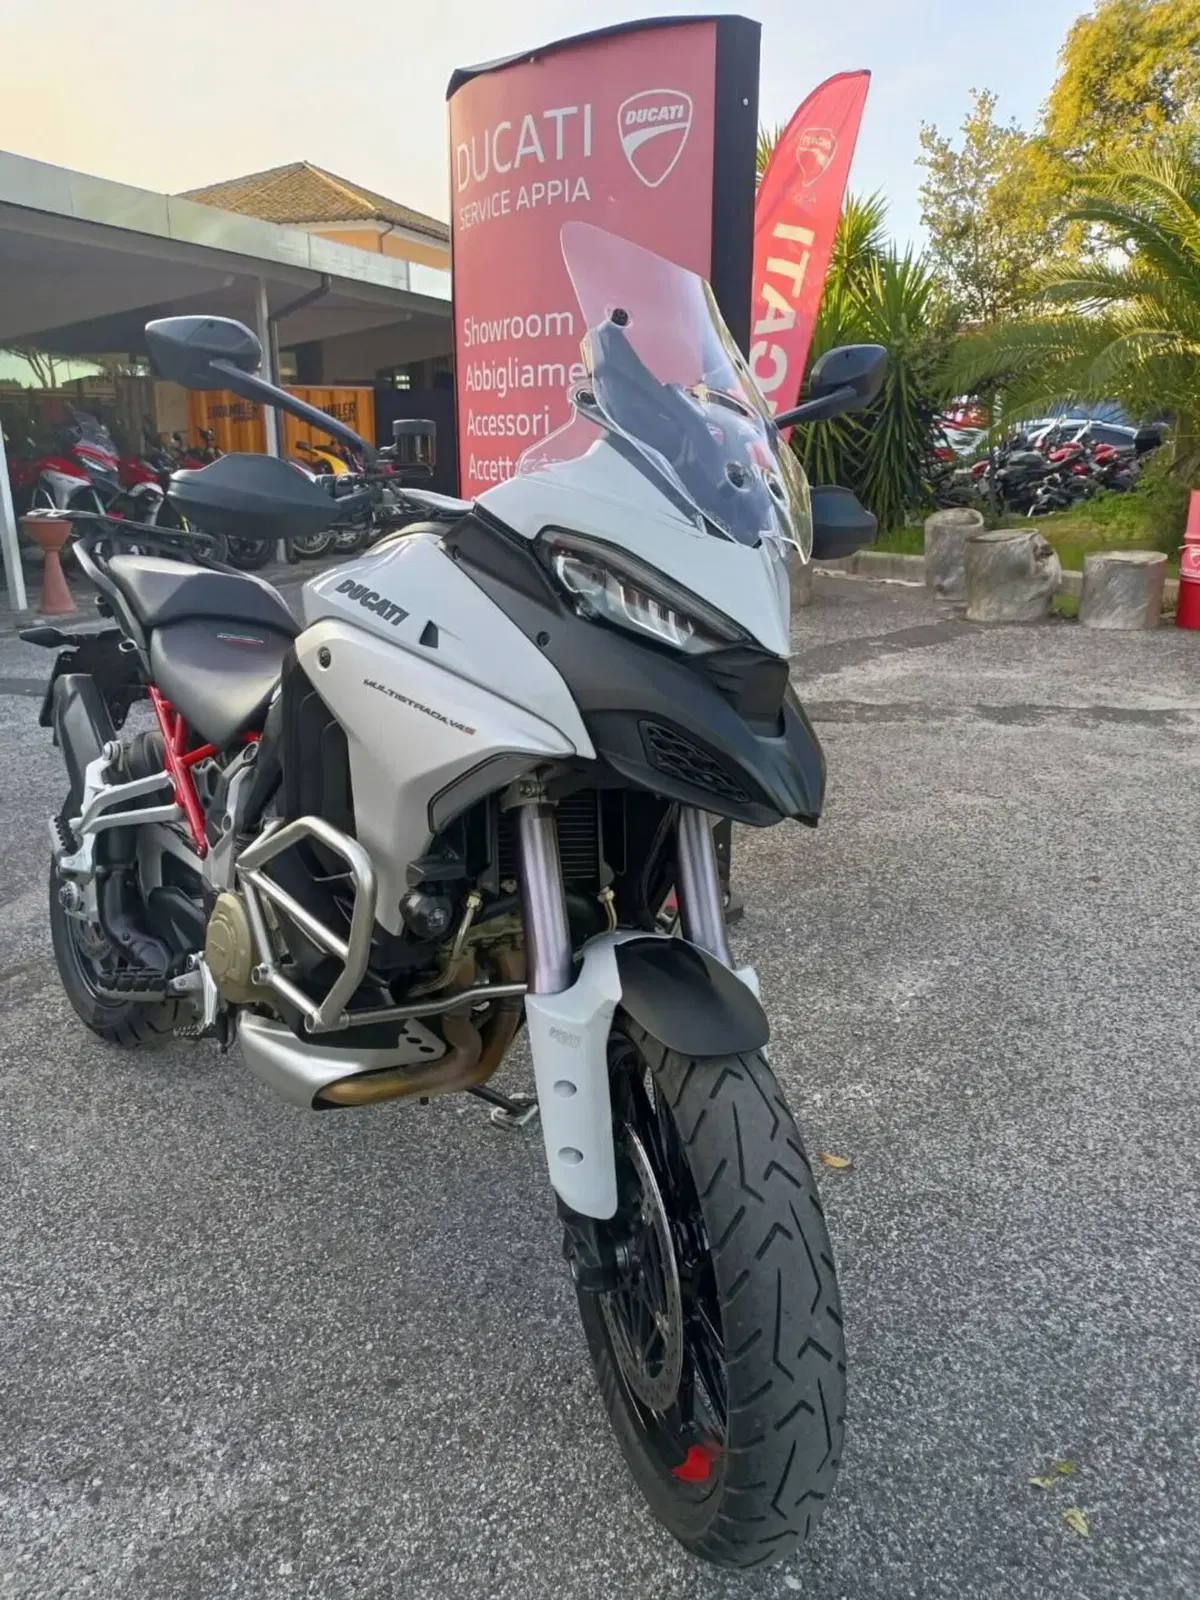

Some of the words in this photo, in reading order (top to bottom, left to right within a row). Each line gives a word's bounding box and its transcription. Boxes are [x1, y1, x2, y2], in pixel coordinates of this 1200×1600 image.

[625, 104, 684, 125] DUCATI
[457, 104, 592, 193] DUCATI
[460, 189, 512, 231] SERVICE
[516, 176, 591, 210] APPIA
[464, 311, 574, 347] Showroom
[465, 356, 588, 398] Abbigliame
[467, 405, 550, 436] Accessori
[335, 579, 411, 627] DUCATI
[363, 678, 448, 725] MULTISTRADA
